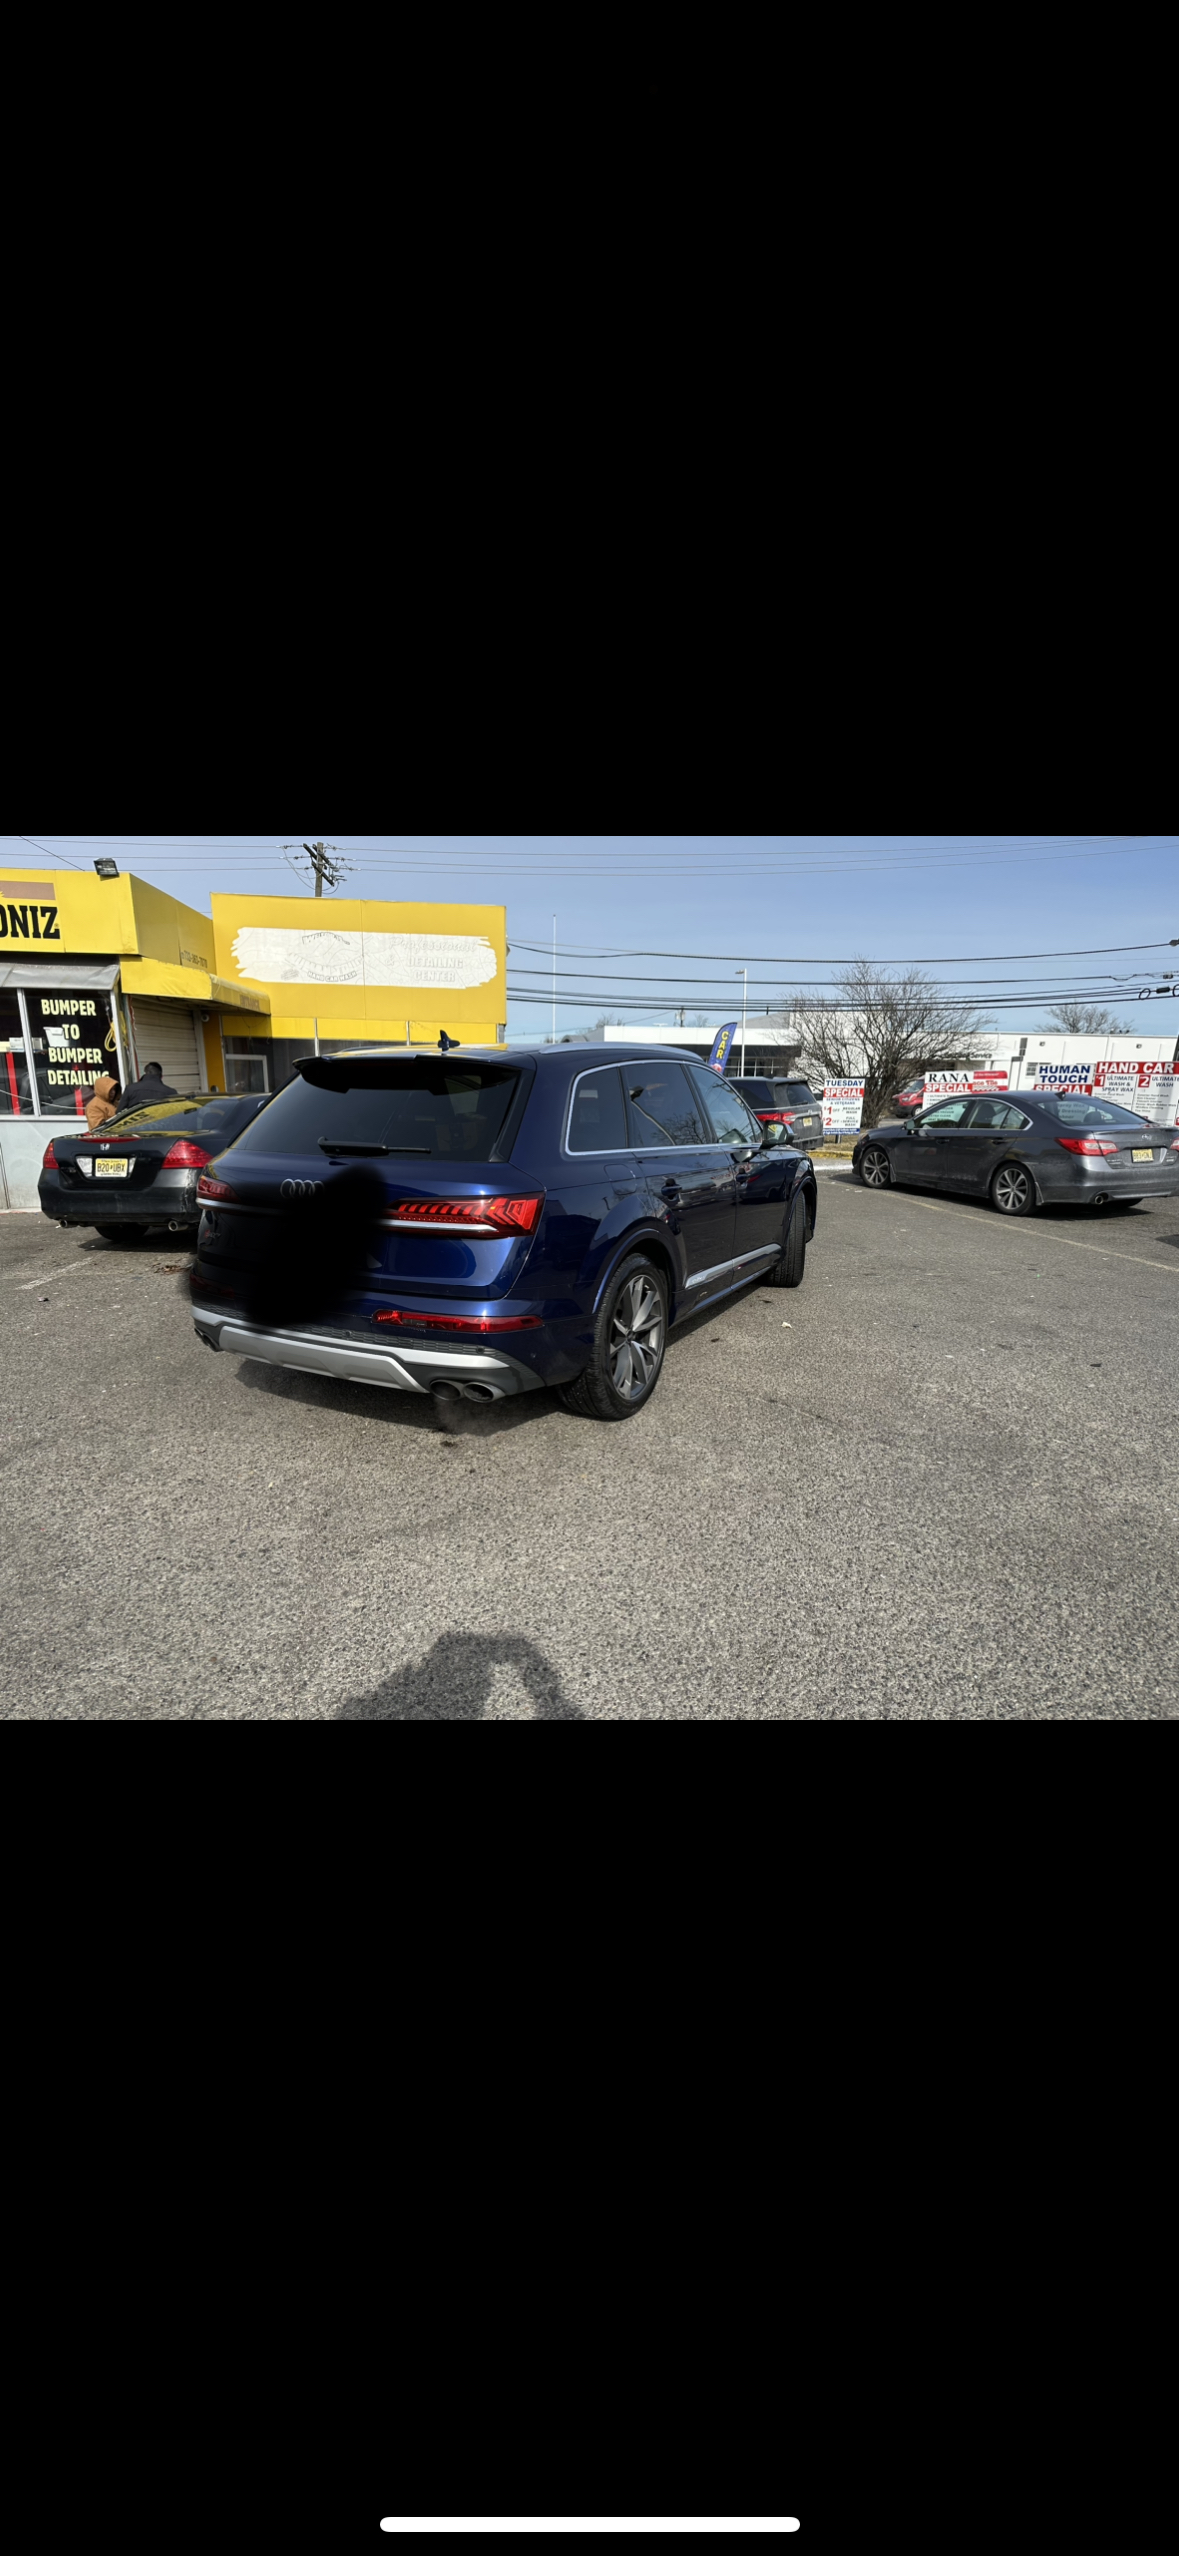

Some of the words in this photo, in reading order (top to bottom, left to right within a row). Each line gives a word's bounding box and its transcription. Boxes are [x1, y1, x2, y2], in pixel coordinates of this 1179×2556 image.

[407, 957, 464, 969] DETAILING
[325, 975, 339, 983] CAR
[339, 970, 358, 982] WASH
[414, 971, 456, 983] CENTER
[41, 999, 97, 1016] BUMPER
[62, 1024, 80, 1040] TO
[716, 1031, 729, 1059] CAR
[48, 1047, 103, 1064] BUMPER
[1039, 1065, 1091, 1074] HUMAN
[1098, 1062, 1139, 1074] HAND
[1142, 1062, 1174, 1074] CAR
[928, 1073, 969, 1082] RANA
[1040, 1075, 1088, 1083] TOUCH
[825, 1088, 863, 1097] SPECIAL
[925, 1083, 971, 1092] SPECIAL
[1035, 1084, 1089, 1096] SPECIAL
